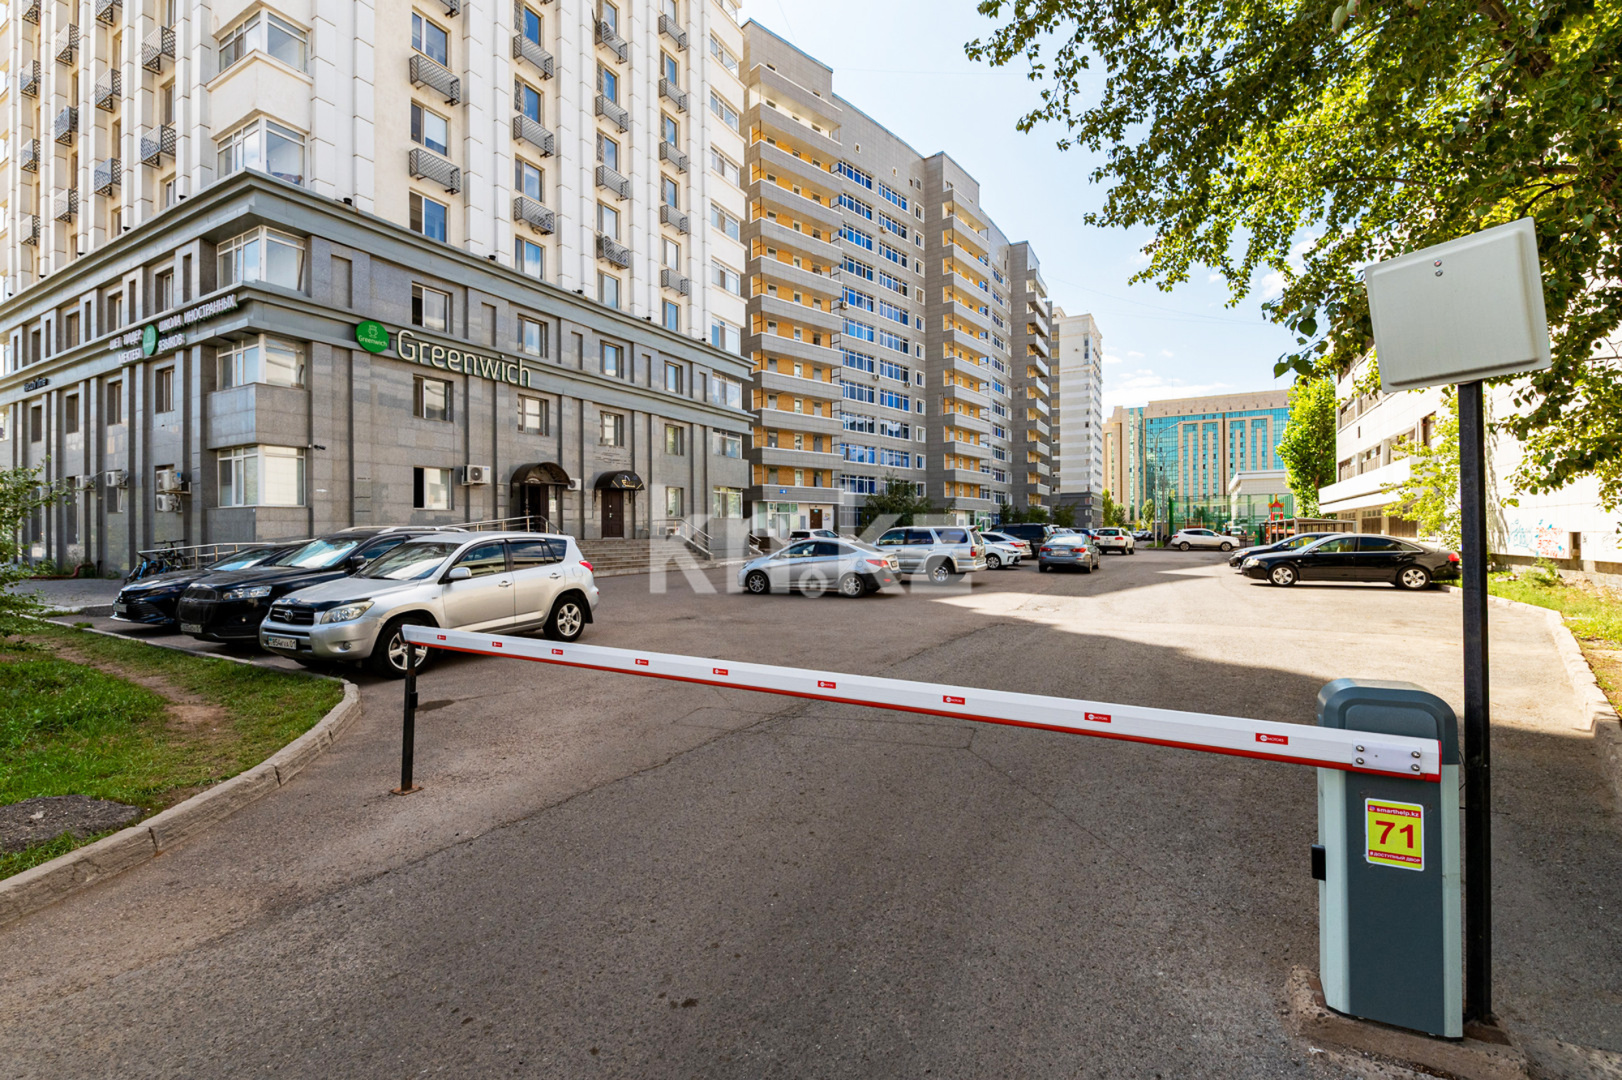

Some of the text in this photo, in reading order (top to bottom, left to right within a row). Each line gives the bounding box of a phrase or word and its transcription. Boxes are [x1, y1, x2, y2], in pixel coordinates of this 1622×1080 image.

[358, 335, 388, 347] Greenwich
[397, 329, 531, 388] Greenwich
[1376, 807, 1419, 817] smarthelp.kz
[1375, 820, 1414, 849] 71
